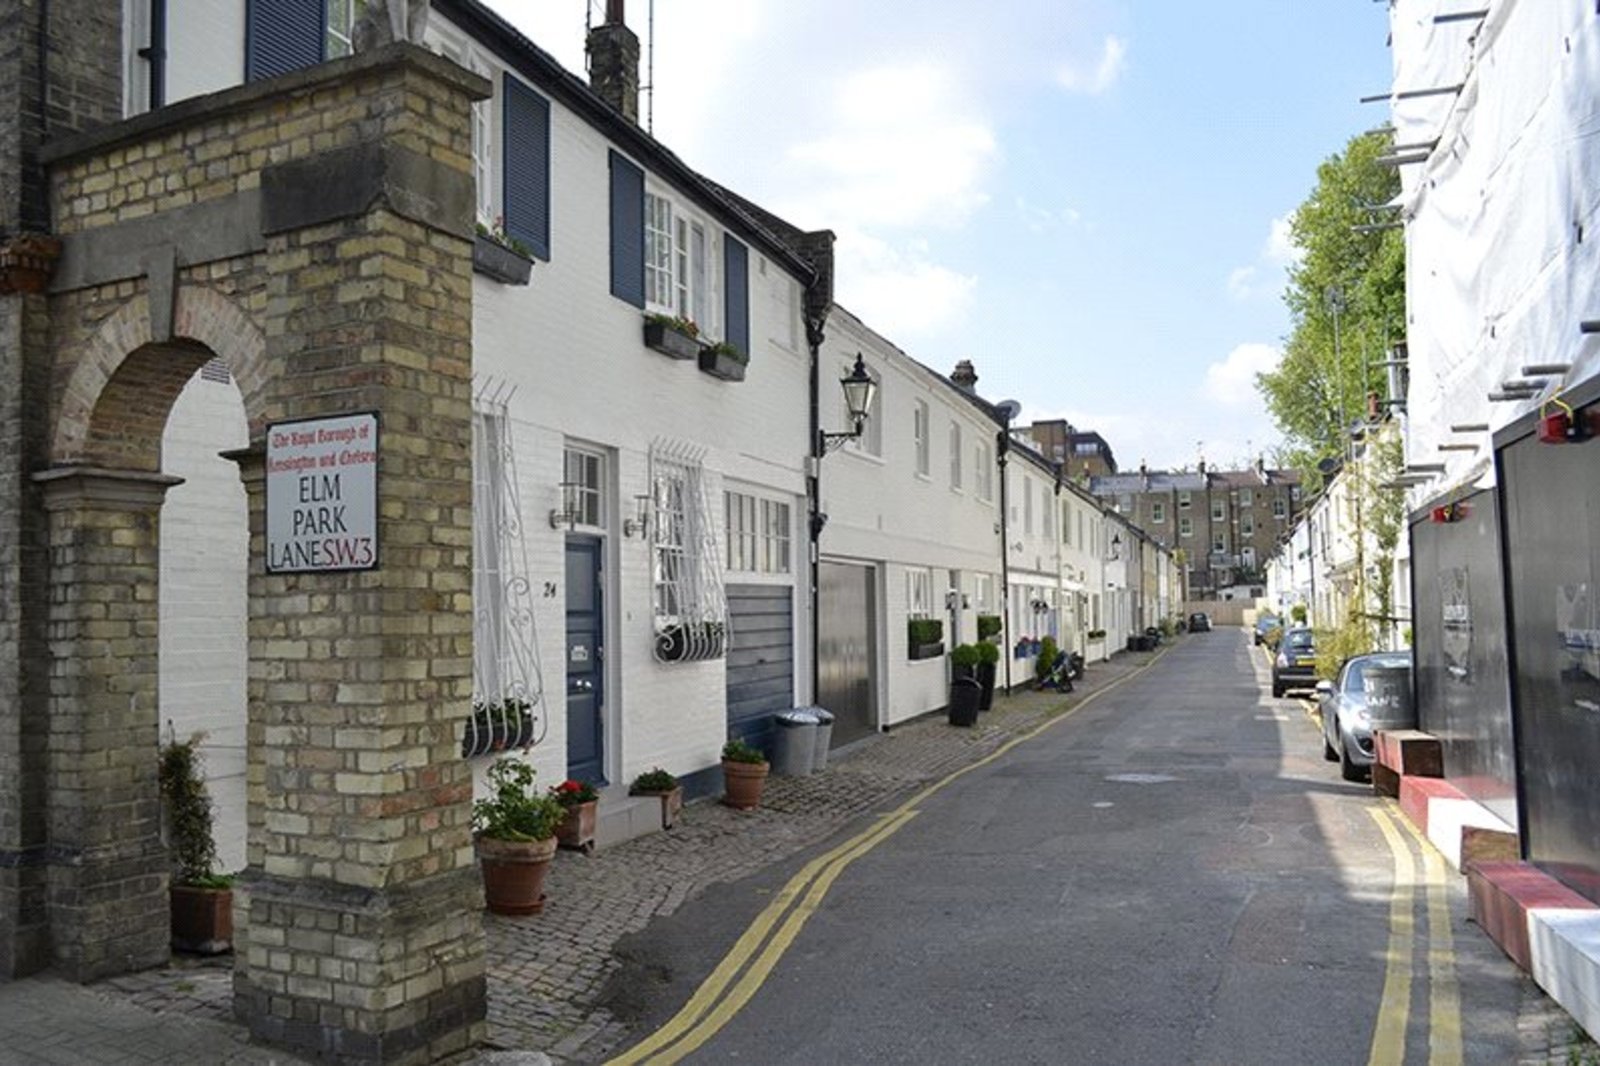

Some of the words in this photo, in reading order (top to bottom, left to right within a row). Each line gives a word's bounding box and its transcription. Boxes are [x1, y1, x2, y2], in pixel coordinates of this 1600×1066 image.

[272, 433, 290, 449] The
[291, 430, 316, 449] Royal
[318, 427, 356, 445] Borough
[359, 424, 369, 440] of
[268, 455, 317, 473] Kensington
[319, 451, 336, 467] and
[299, 473, 341, 503] ELM
[293, 505, 348, 536] PARK
[270, 540, 322, 569] LANE
